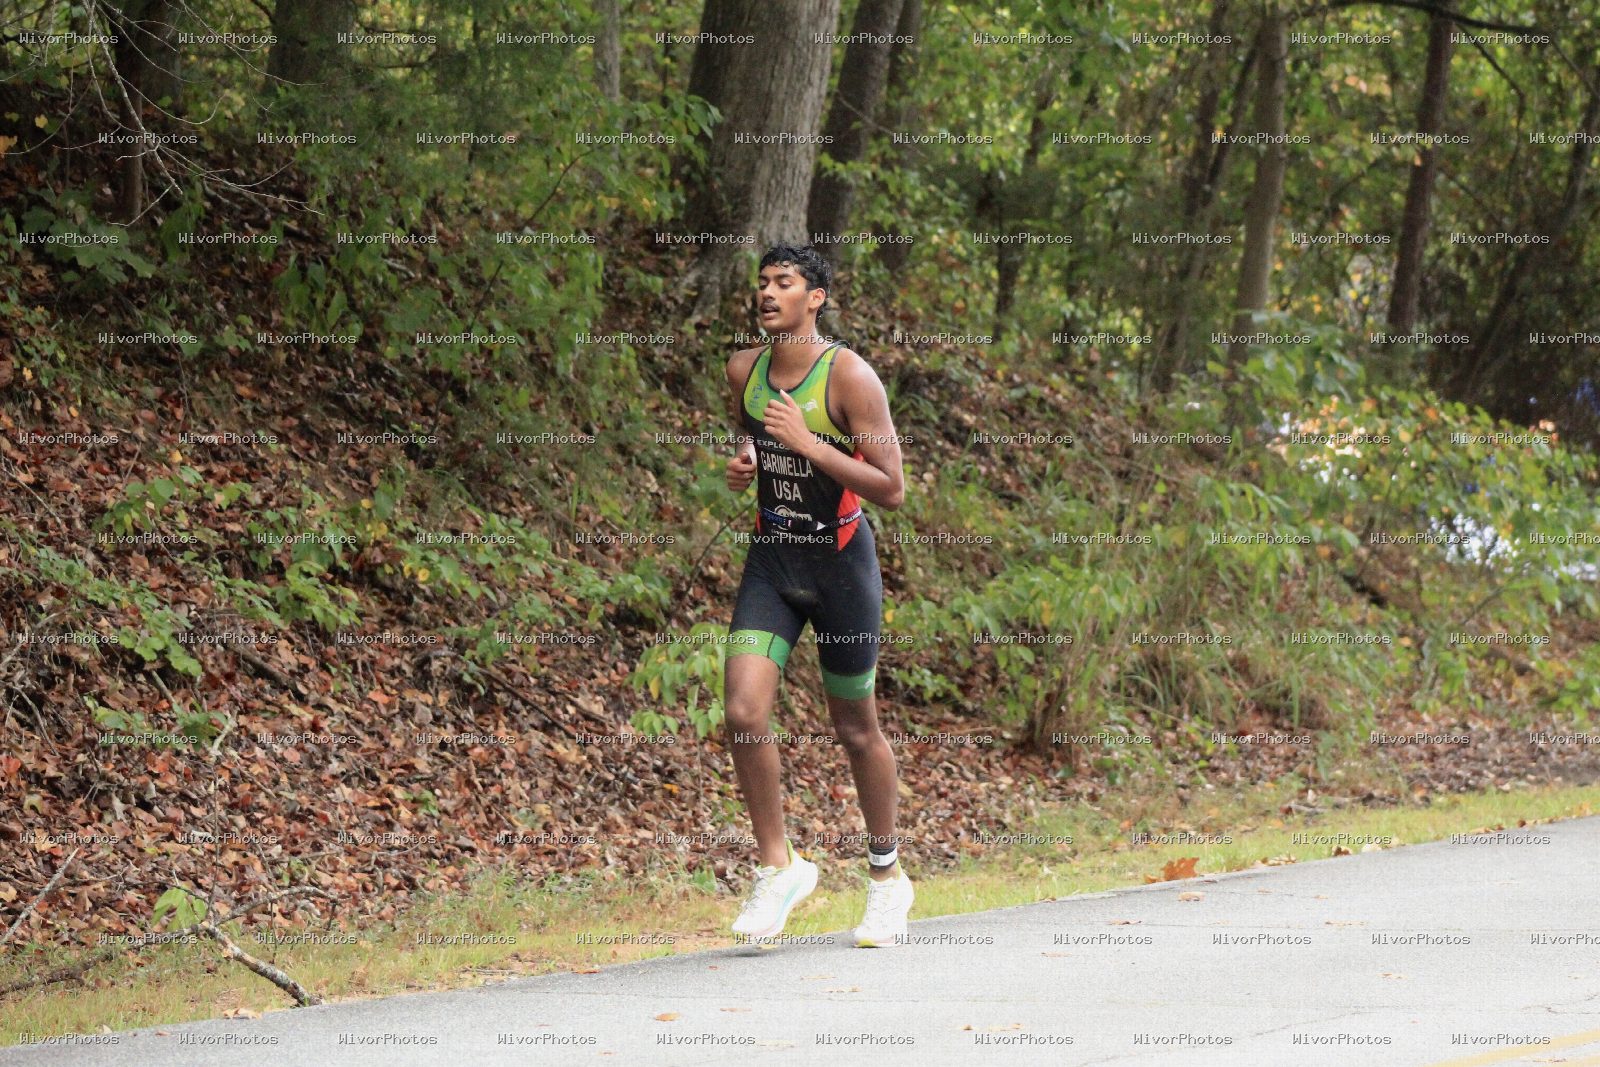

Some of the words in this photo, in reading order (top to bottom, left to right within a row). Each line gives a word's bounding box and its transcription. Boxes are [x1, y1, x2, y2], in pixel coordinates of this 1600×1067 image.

[757, 440, 790, 450] EXPLO
[761, 451, 813, 477] GARIMELLA
[773, 479, 802, 502] USA
